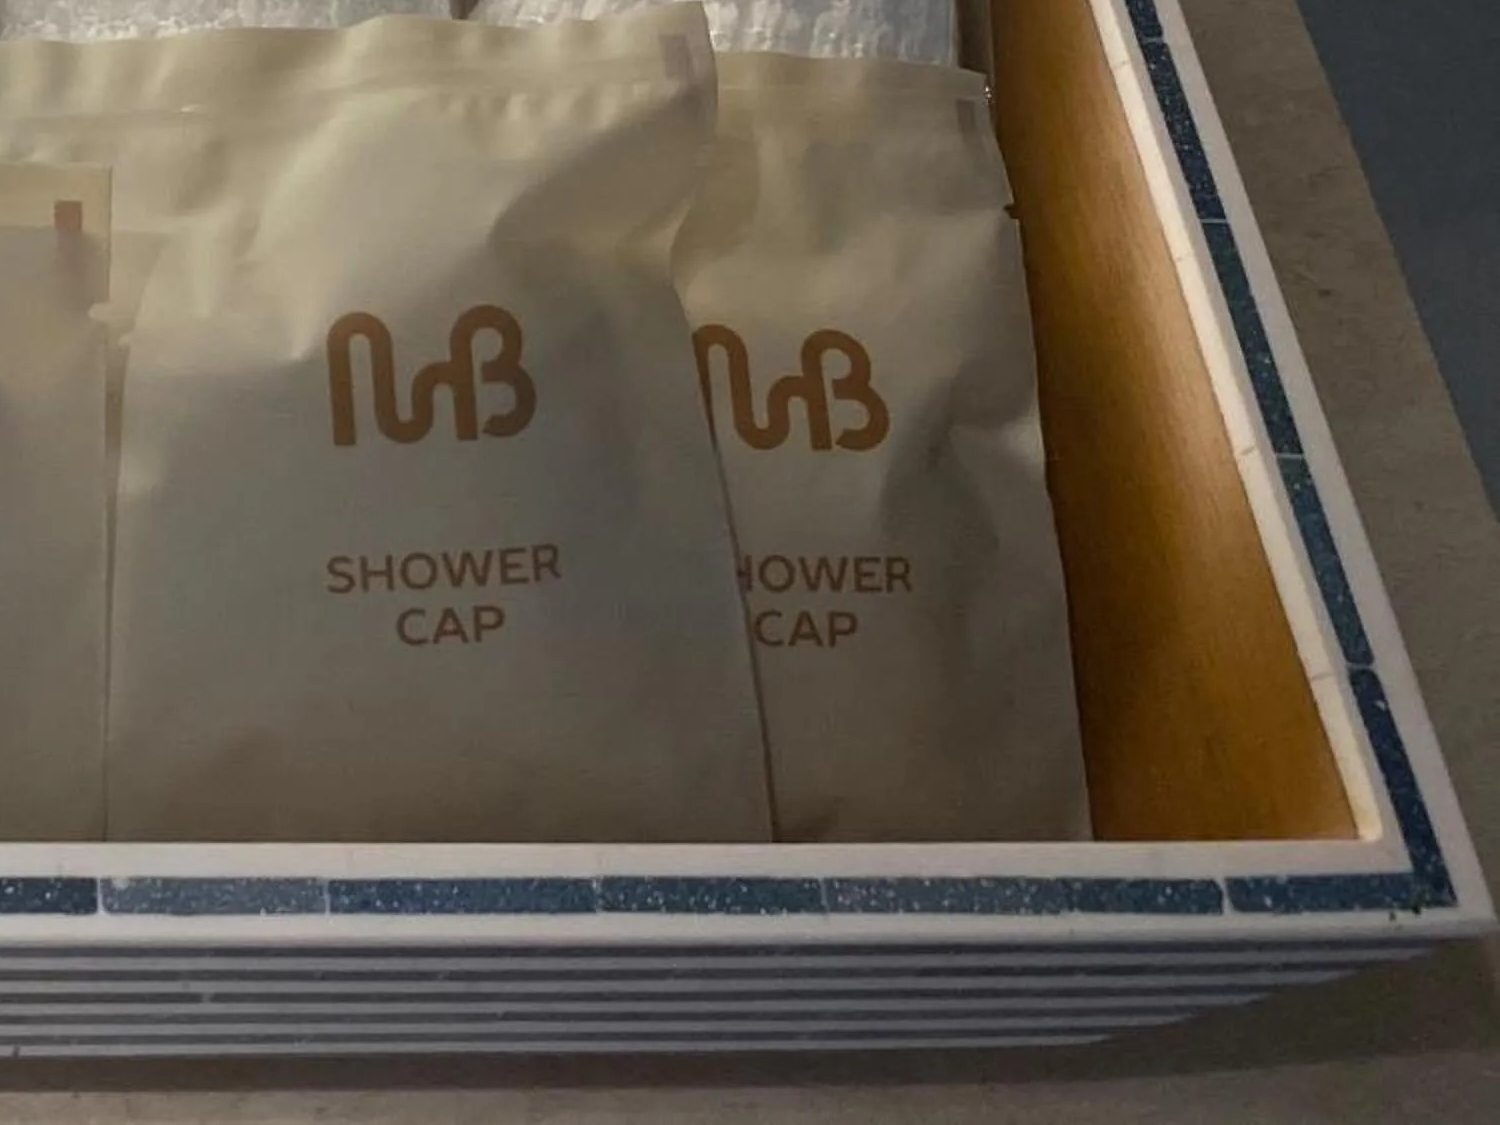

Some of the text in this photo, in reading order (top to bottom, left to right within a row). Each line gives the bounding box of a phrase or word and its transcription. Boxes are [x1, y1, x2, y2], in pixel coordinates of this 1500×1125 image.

[326, 543, 562, 594] SHOWER
[737, 554, 913, 593] OWER
[396, 605, 506, 647] CAP
[752, 609, 859, 648] CAP
